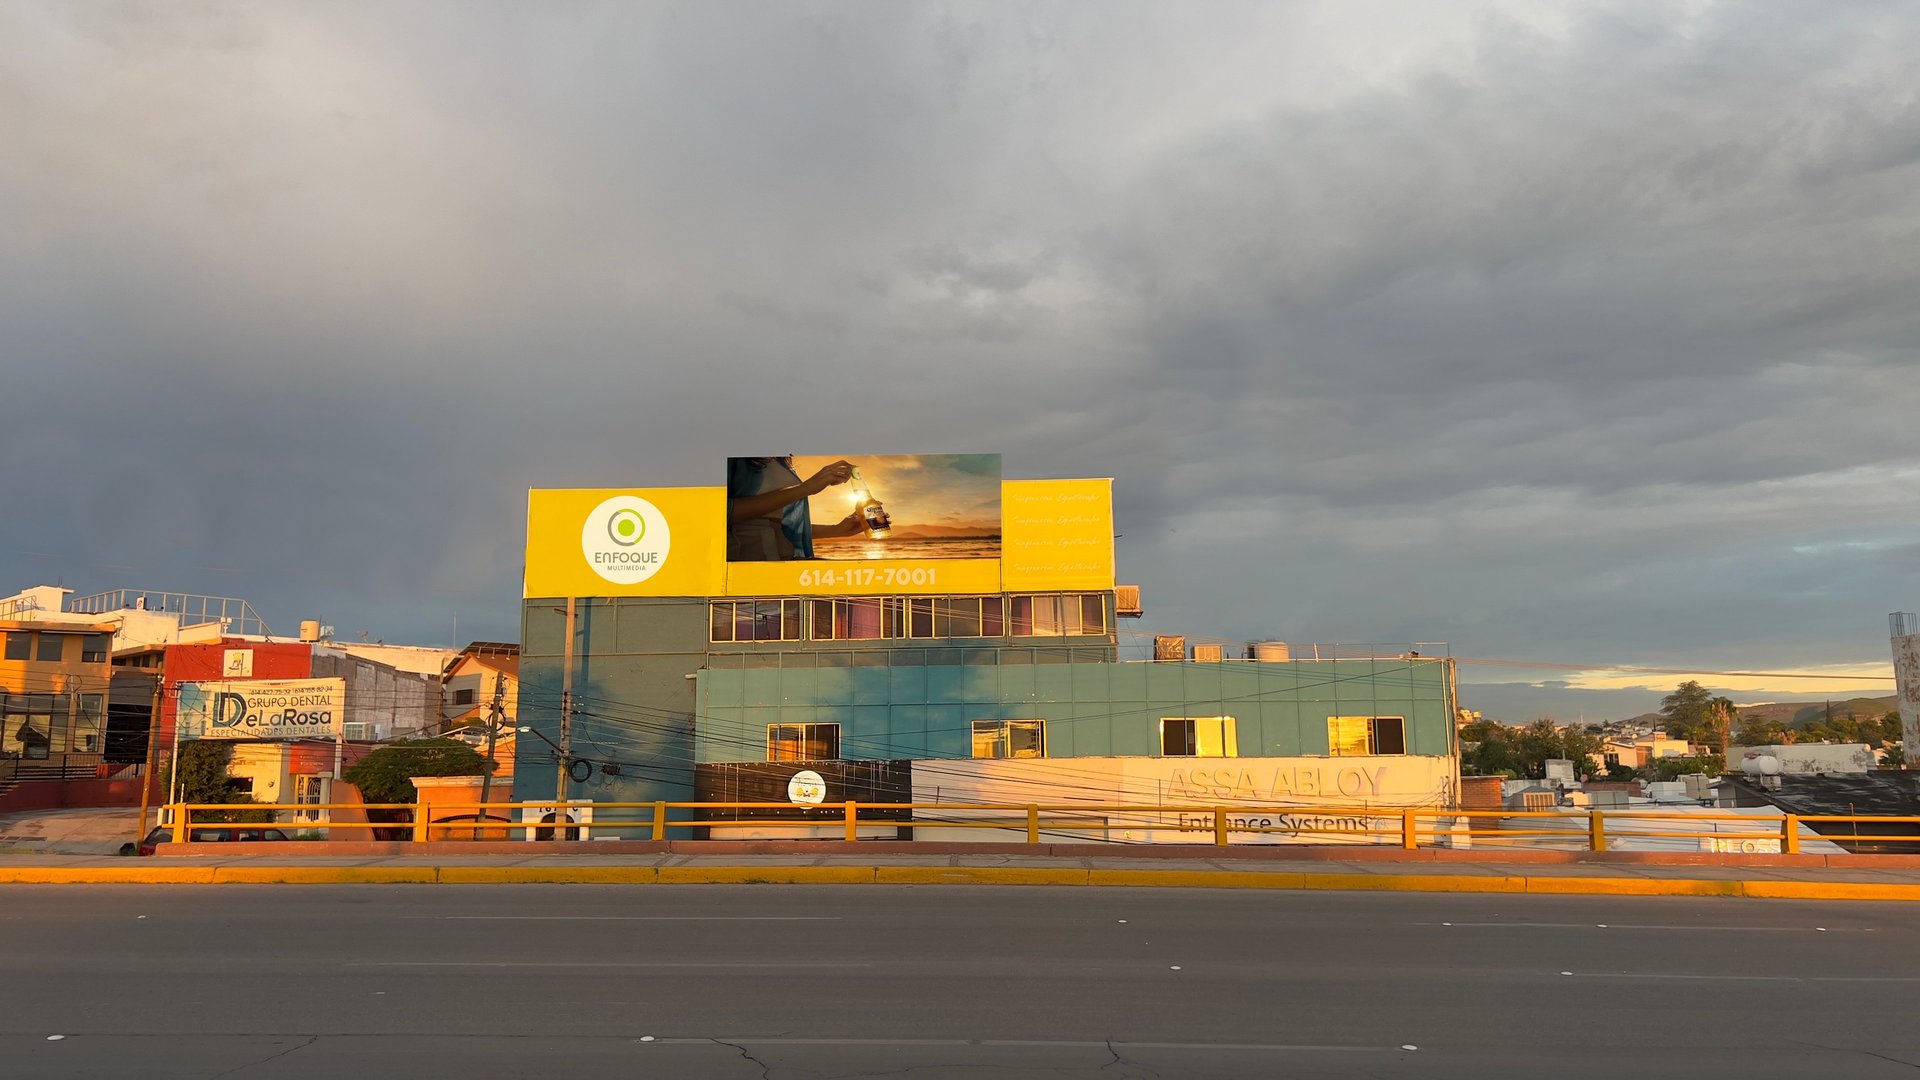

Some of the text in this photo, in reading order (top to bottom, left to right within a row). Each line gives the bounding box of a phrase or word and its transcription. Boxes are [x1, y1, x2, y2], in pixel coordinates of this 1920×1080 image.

[594, 552, 658, 564] ENFOQUE
[798, 567, 936, 586] 614-117-7001
[247, 695, 332, 708] GRUPO DENTAL
[211, 726, 331, 737] ESPECIALIDADES DENTALES
[1167, 766, 1388, 798] ASSA ABLOY
[1179, 813, 1369, 838] Entance Systems
